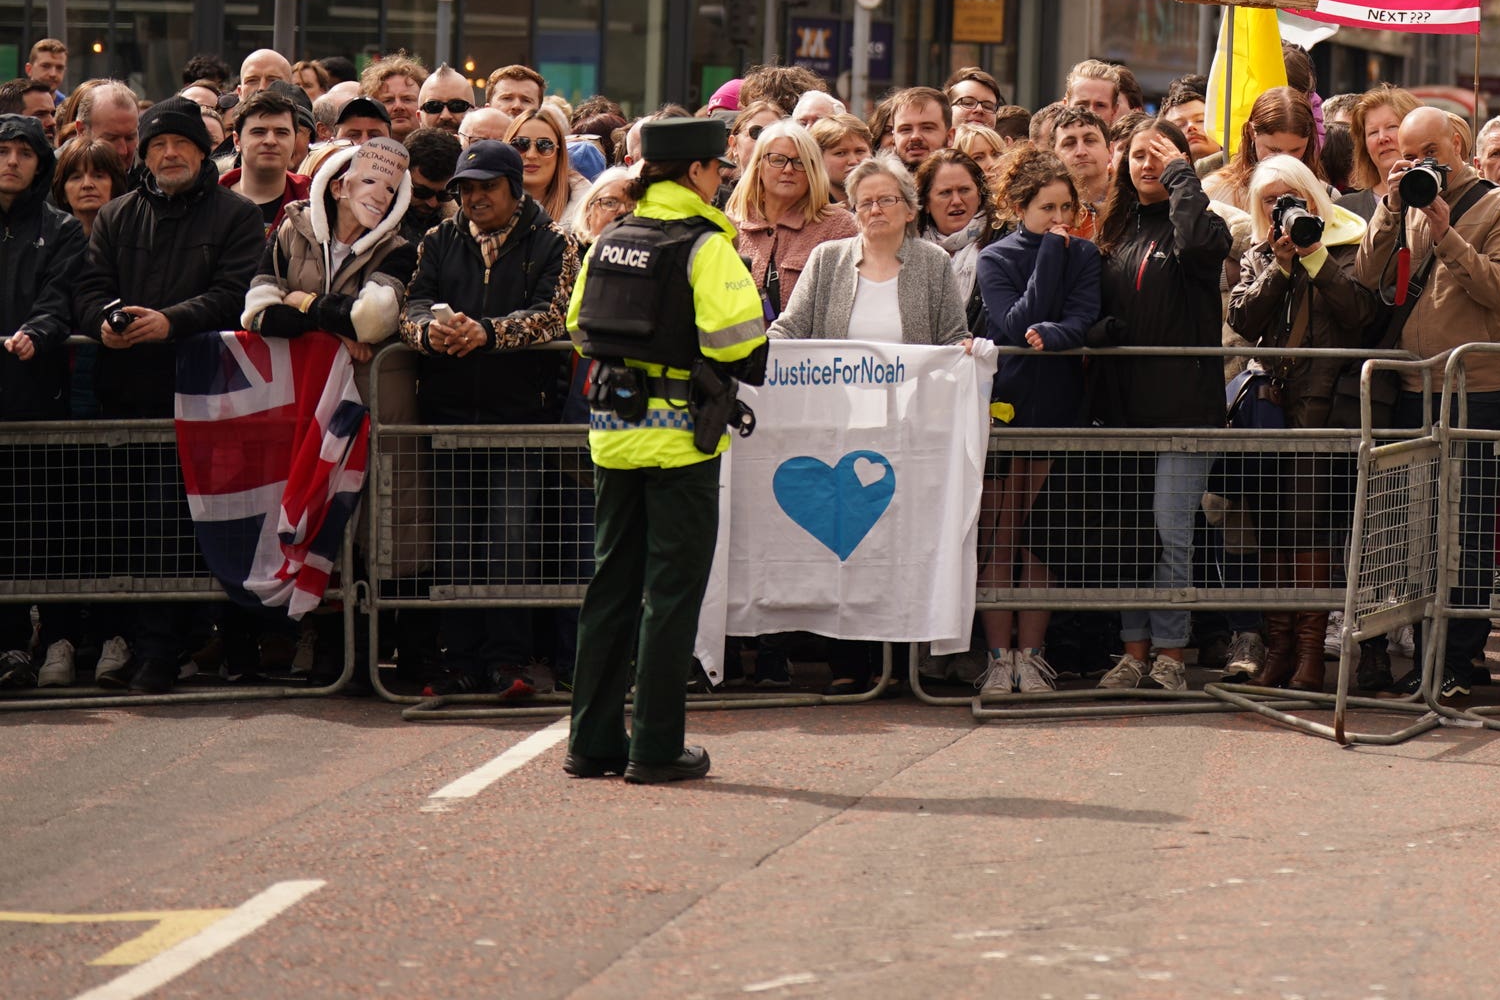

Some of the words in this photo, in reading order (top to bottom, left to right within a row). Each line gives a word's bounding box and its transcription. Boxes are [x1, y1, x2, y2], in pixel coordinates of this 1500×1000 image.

[1367, 9, 1432, 24] NEXT???
[599, 245, 650, 268] POLICE
[764, 356, 905, 386] JusticeForNoah
